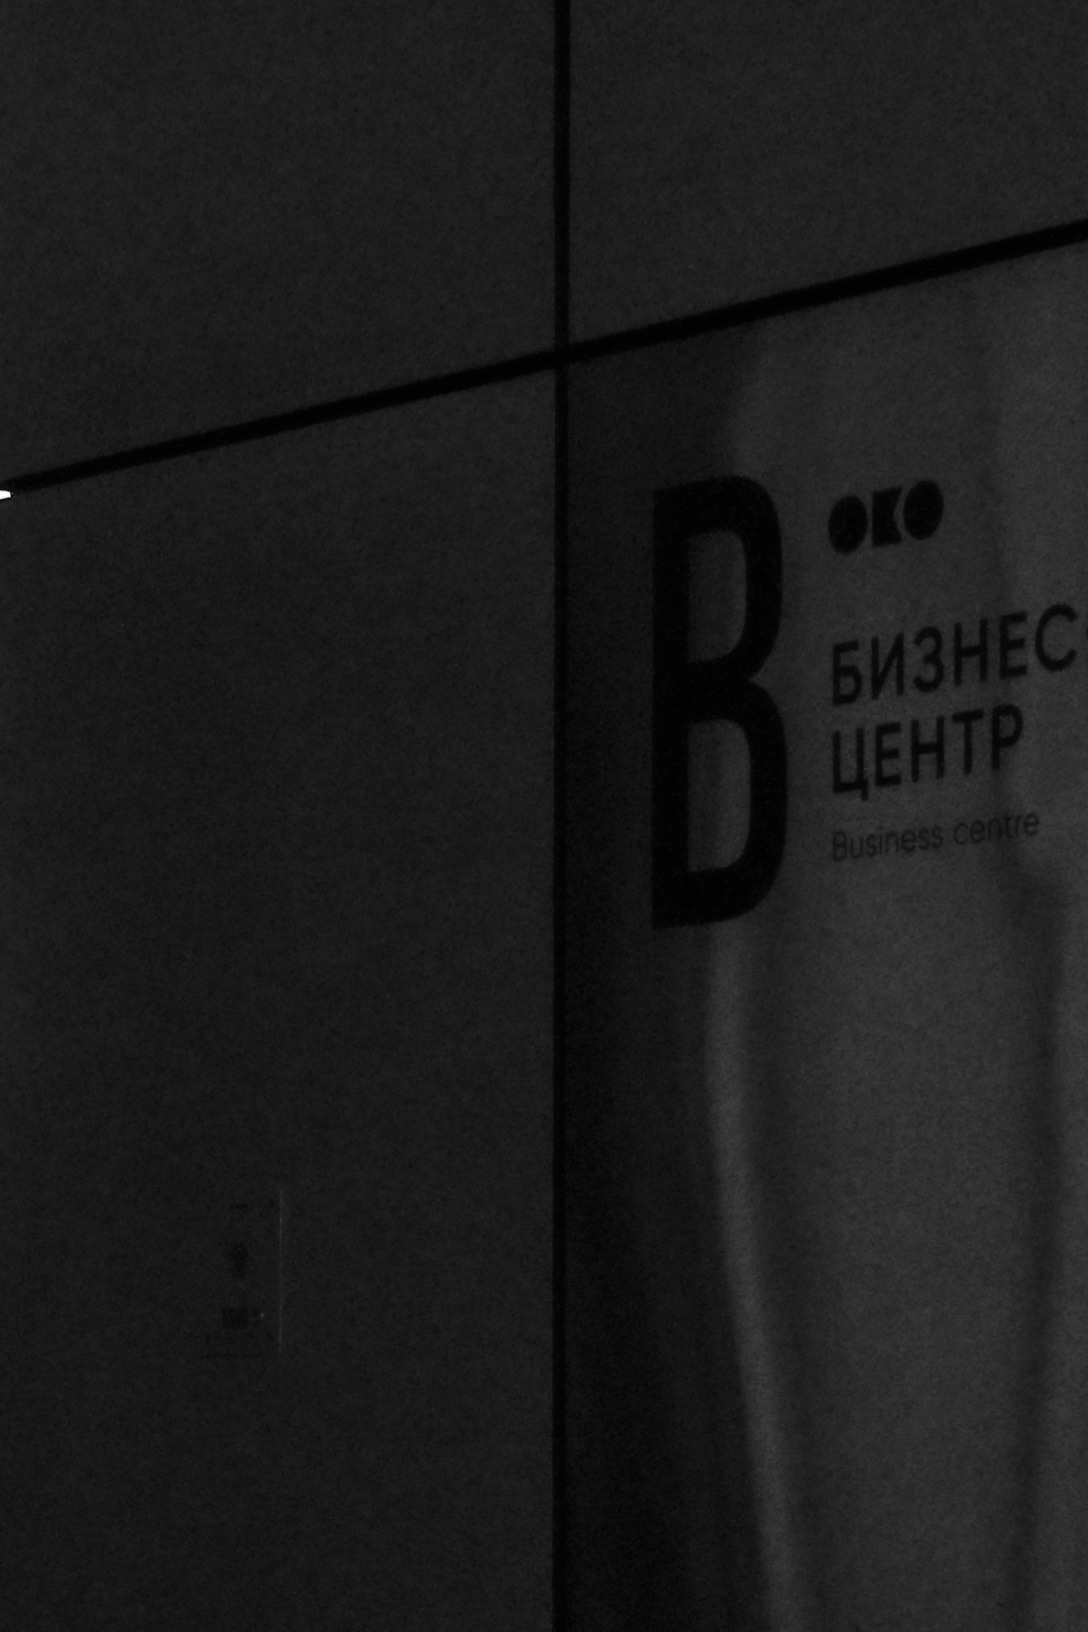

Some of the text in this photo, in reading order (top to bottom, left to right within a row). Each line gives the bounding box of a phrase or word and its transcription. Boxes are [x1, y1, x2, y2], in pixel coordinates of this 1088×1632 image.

[832, 603, 1088, 707] БИЗНЕС
[832, 704, 1024, 801] ЦЕНТР
[832, 812, 1040, 863] Business centre
